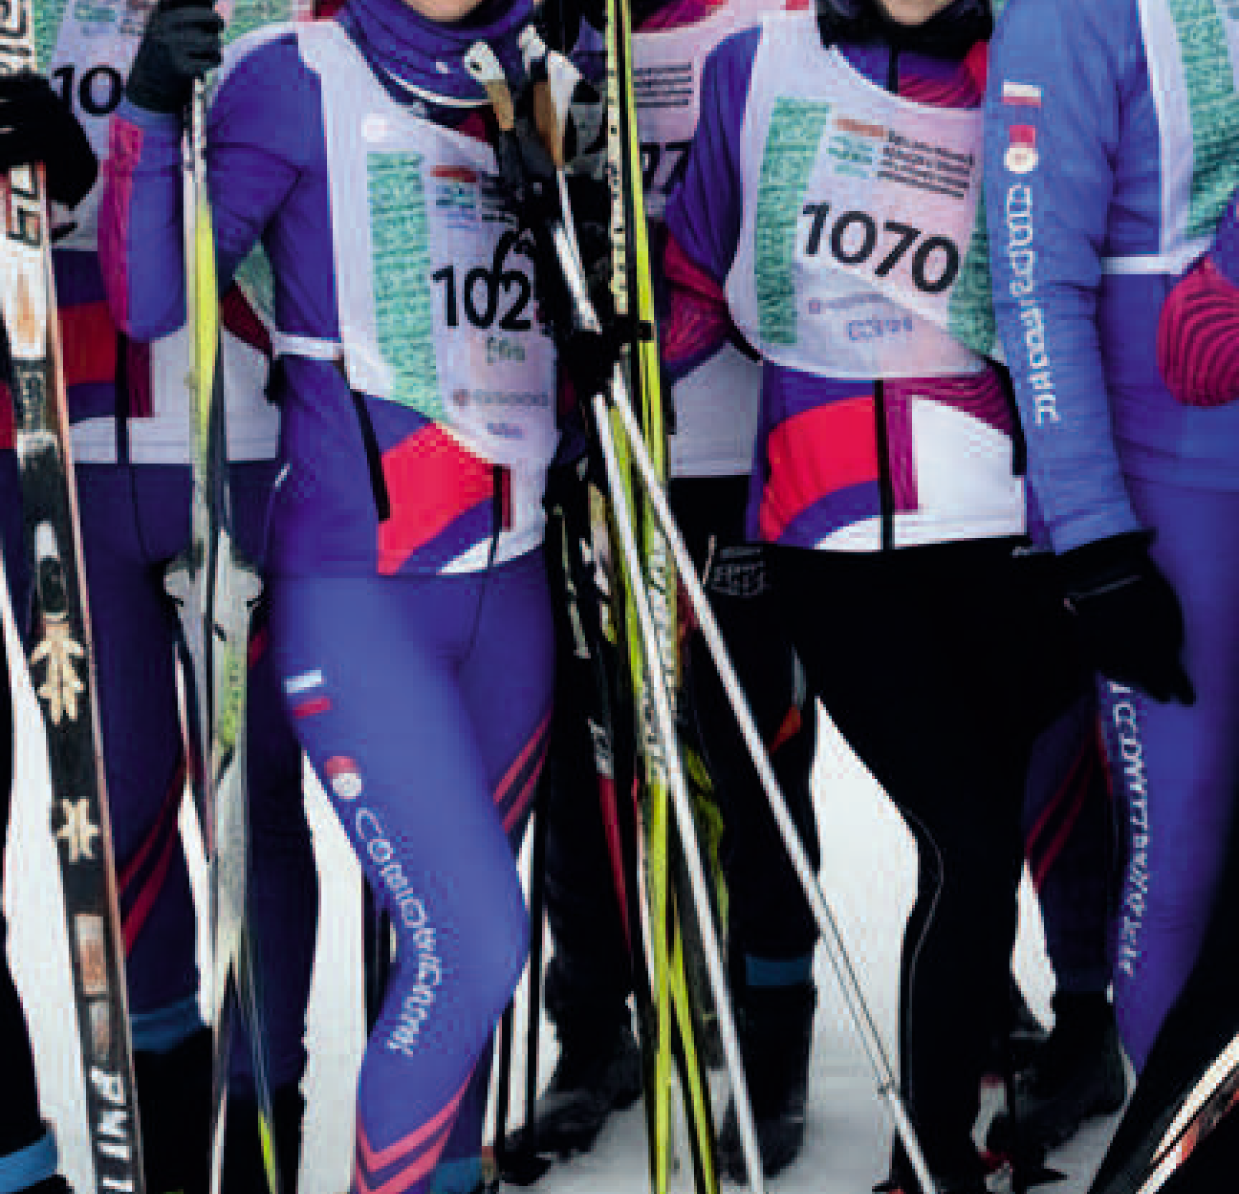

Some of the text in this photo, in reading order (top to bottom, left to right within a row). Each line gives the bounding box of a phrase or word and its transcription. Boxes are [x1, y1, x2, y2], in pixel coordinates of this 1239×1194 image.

[54, 64, 123, 117] 10
[802, 202, 959, 293] 1070
[431, 264, 533, 330] 102
